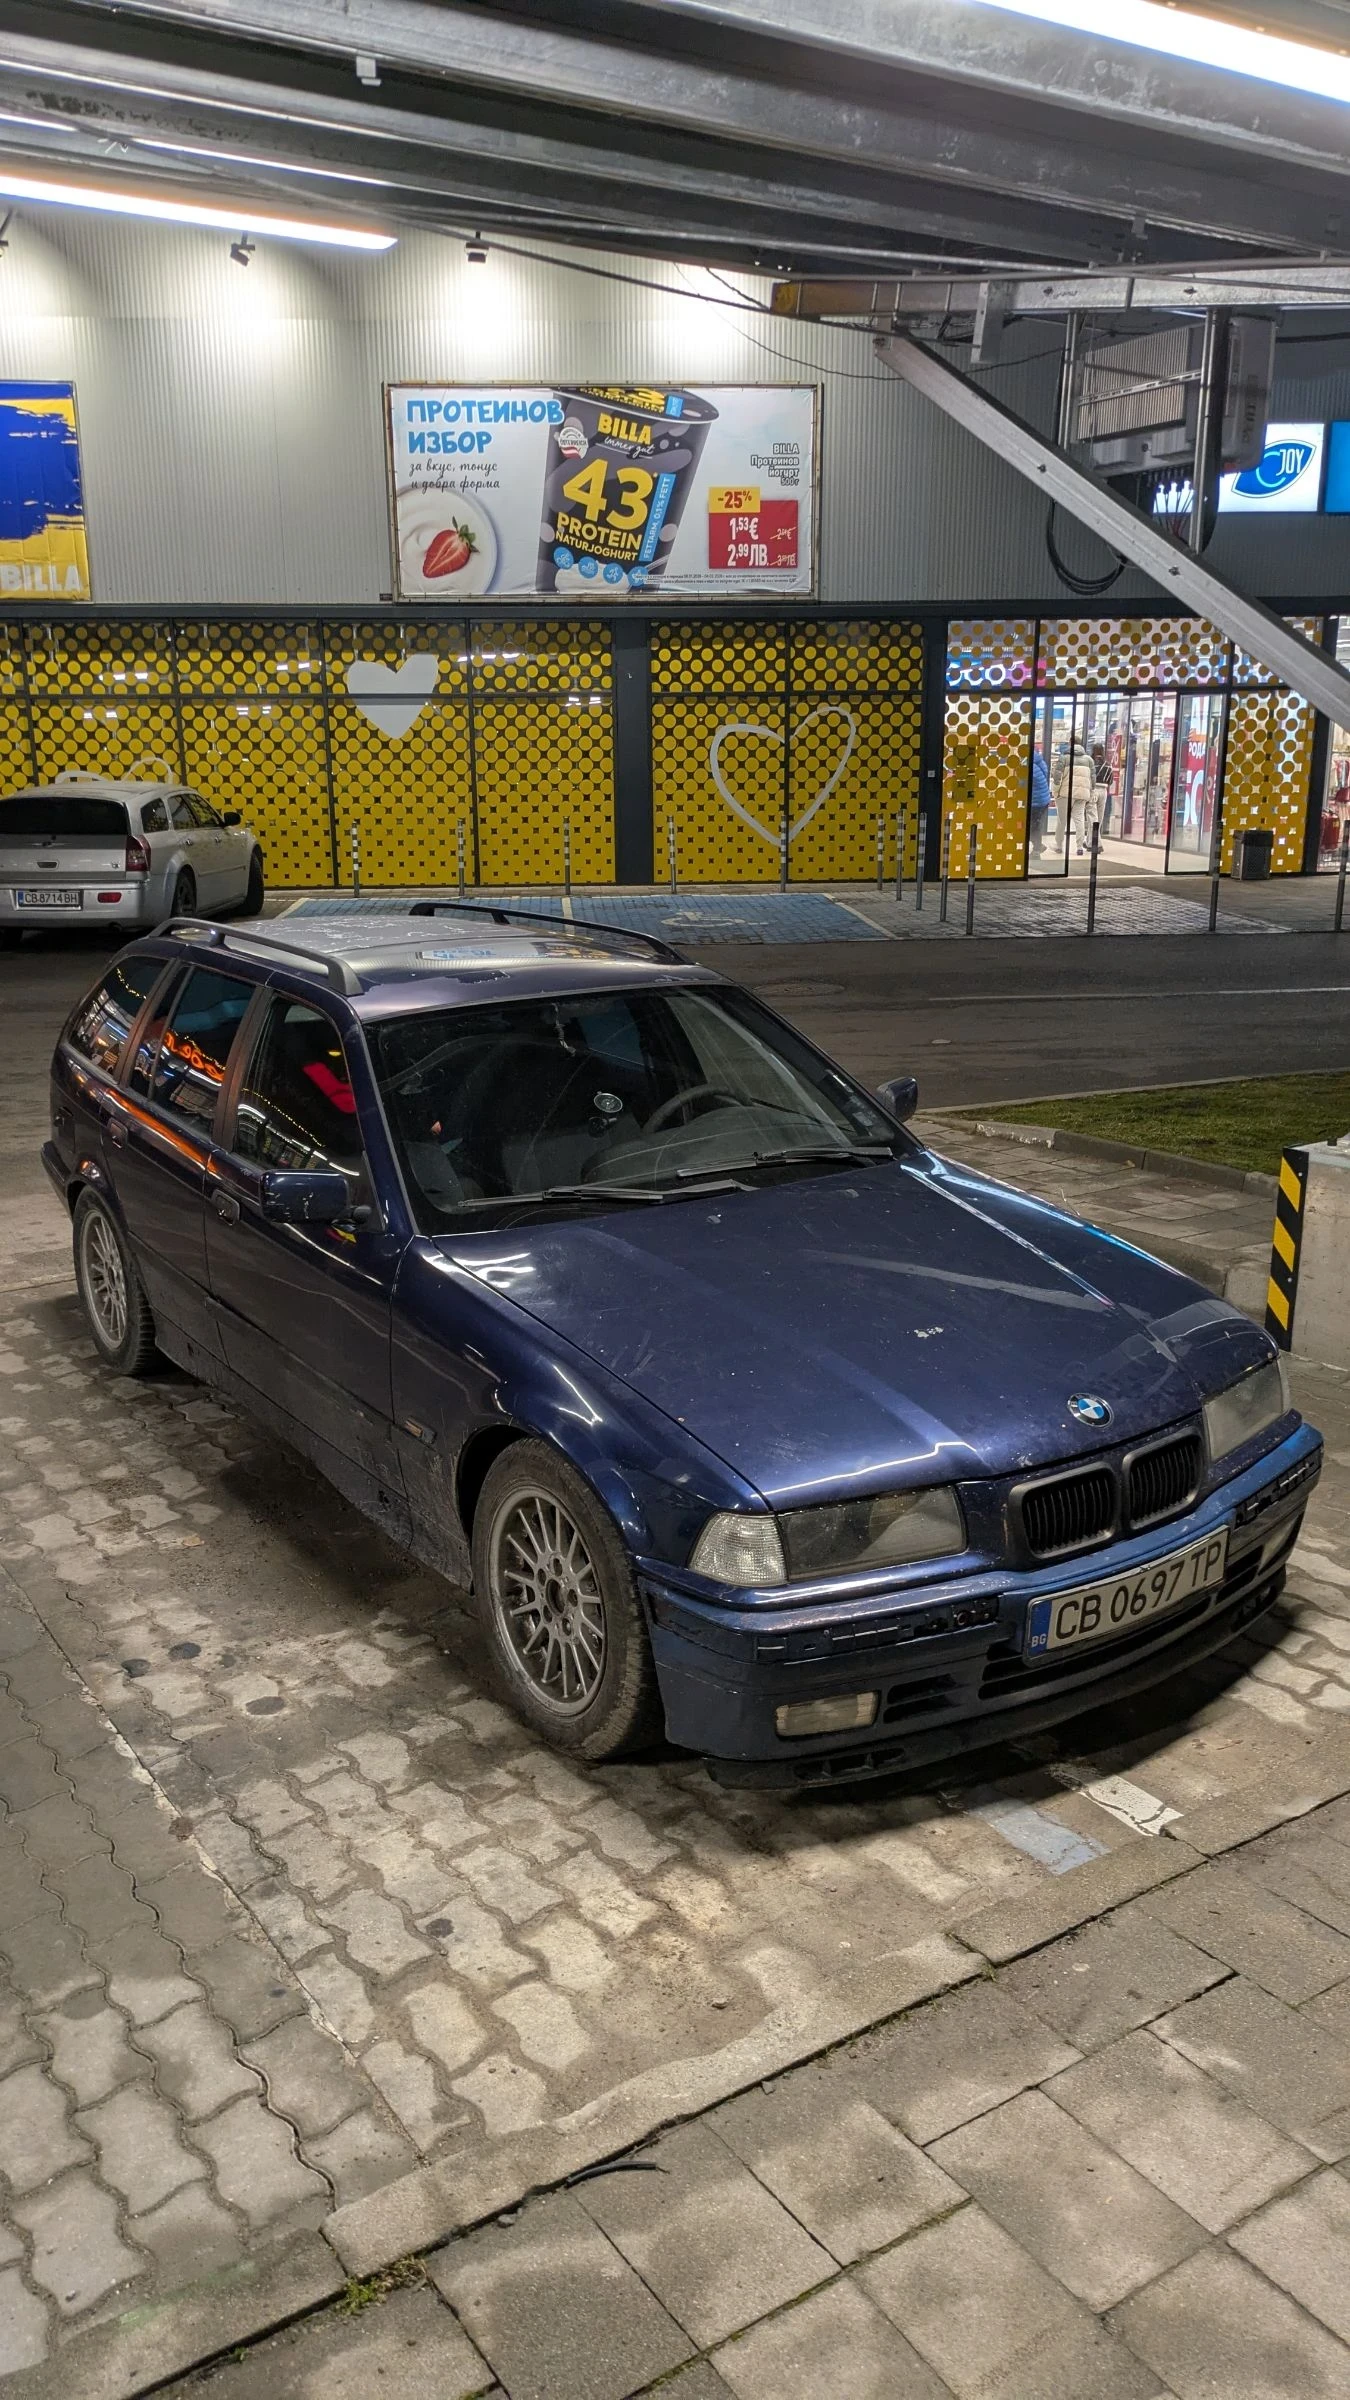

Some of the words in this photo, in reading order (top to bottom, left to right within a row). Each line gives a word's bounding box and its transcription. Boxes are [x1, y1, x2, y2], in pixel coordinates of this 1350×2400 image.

[407, 400, 563, 424] ПРОТЕИНОВ
[597, 412, 652, 445] BILLA
[408, 431, 492, 454] ИЗБОР
[604, 436, 634, 450] immer
[632, 444, 655, 459] gut
[772, 443, 800, 455] BILLA
[409, 462, 422, 477] за
[426, 458, 456, 477] вкус,
[460, 462, 498, 477] тонус
[750, 455, 799, 468] Протеинов
[768, 466, 800, 478] йогурт
[1275, 448, 1305, 477] JOY
[411, 480, 419, 489] и
[421, 476, 456, 494] добра
[459, 475, 501, 493] форма
[659, 477, 671, 499] FETT
[718, 490, 753, 509] -25%
[556, 511, 643, 551] PROTEIN
[729, 517, 759, 540] 1,53€
[555, 531, 638, 562] NATURJOGHURT
[0, 564, 83, 593] BILLA
[24, 893, 38, 904] CB
[39, 893, 61, 904] 8714
[64, 893, 77, 904] BH
[1056, 1594, 1101, 1640] CB
[1110, 1560, 1185, 1623] 0697
[1191, 1541, 1222, 1587] TP
[1031, 1633, 1047, 1648] BG
